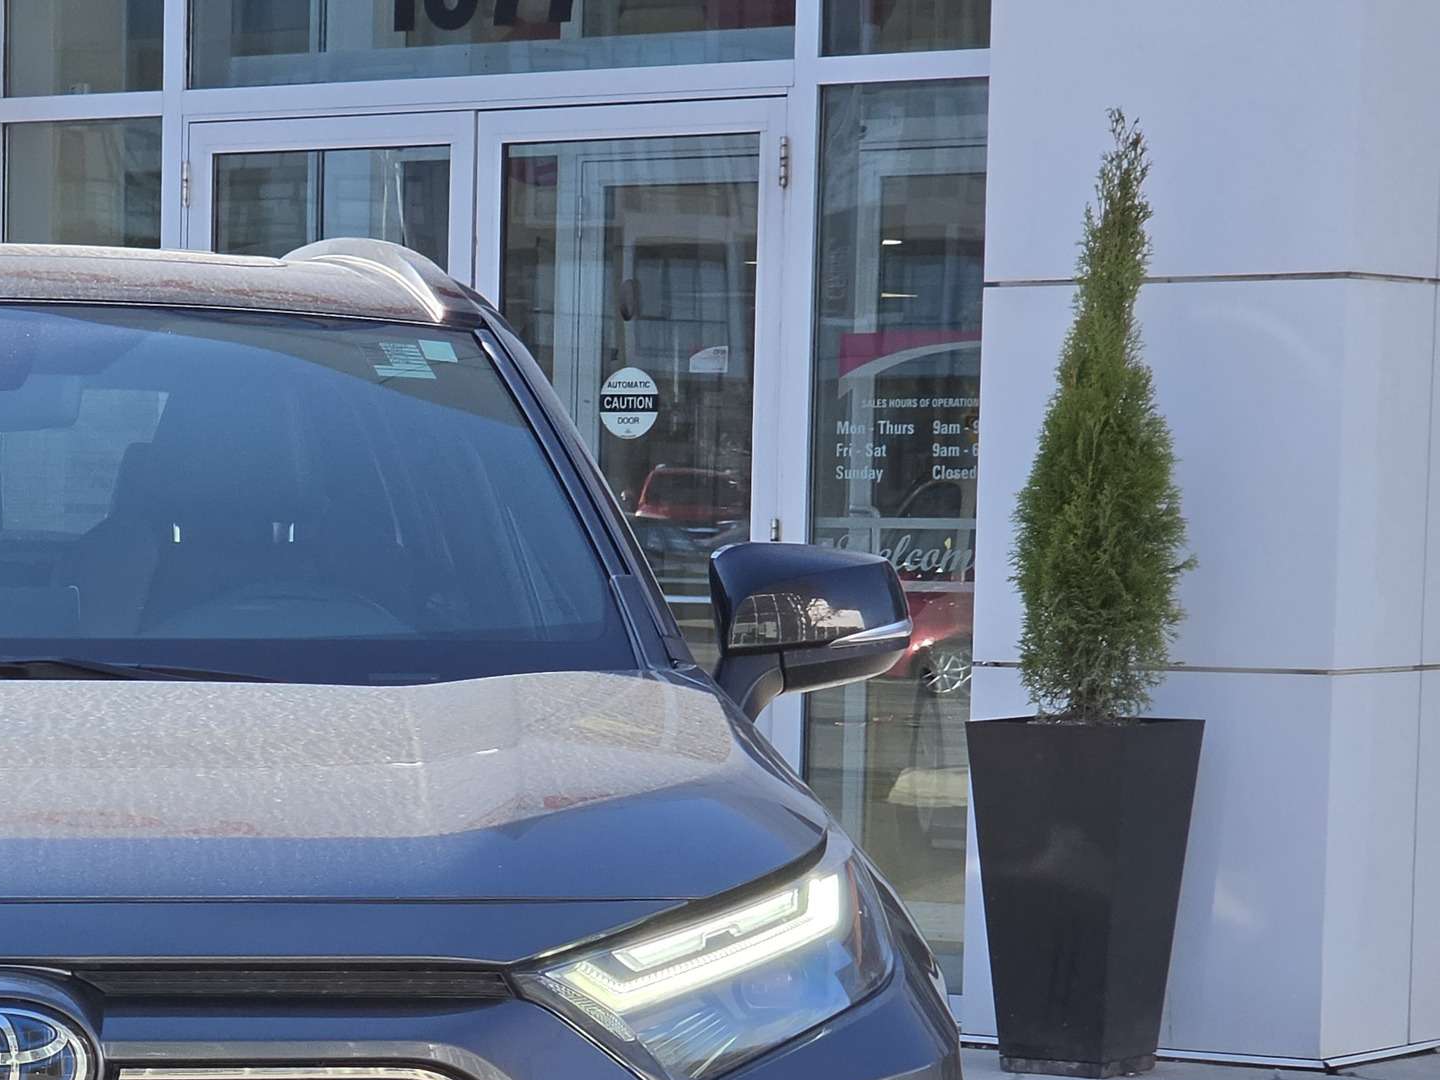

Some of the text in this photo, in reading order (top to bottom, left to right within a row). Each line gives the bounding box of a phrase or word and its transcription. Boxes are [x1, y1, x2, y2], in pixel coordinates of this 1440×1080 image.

[607, 381, 651, 389] AUTOMATIC
[603, 396, 653, 409] CAUTION
[889, 398, 918, 408] HOURS
[919, 398, 931, 408] OF
[617, 416, 640, 425] DOOR
[835, 420, 865, 434] Mon
[877, 420, 915, 435] Thurs
[932, 420, 961, 434] 9am
[835, 443, 853, 457] Fri
[864, 443, 887, 457] Sat
[932, 443, 961, 457] 9am
[835, 465, 977, 483] Sunday Closed
